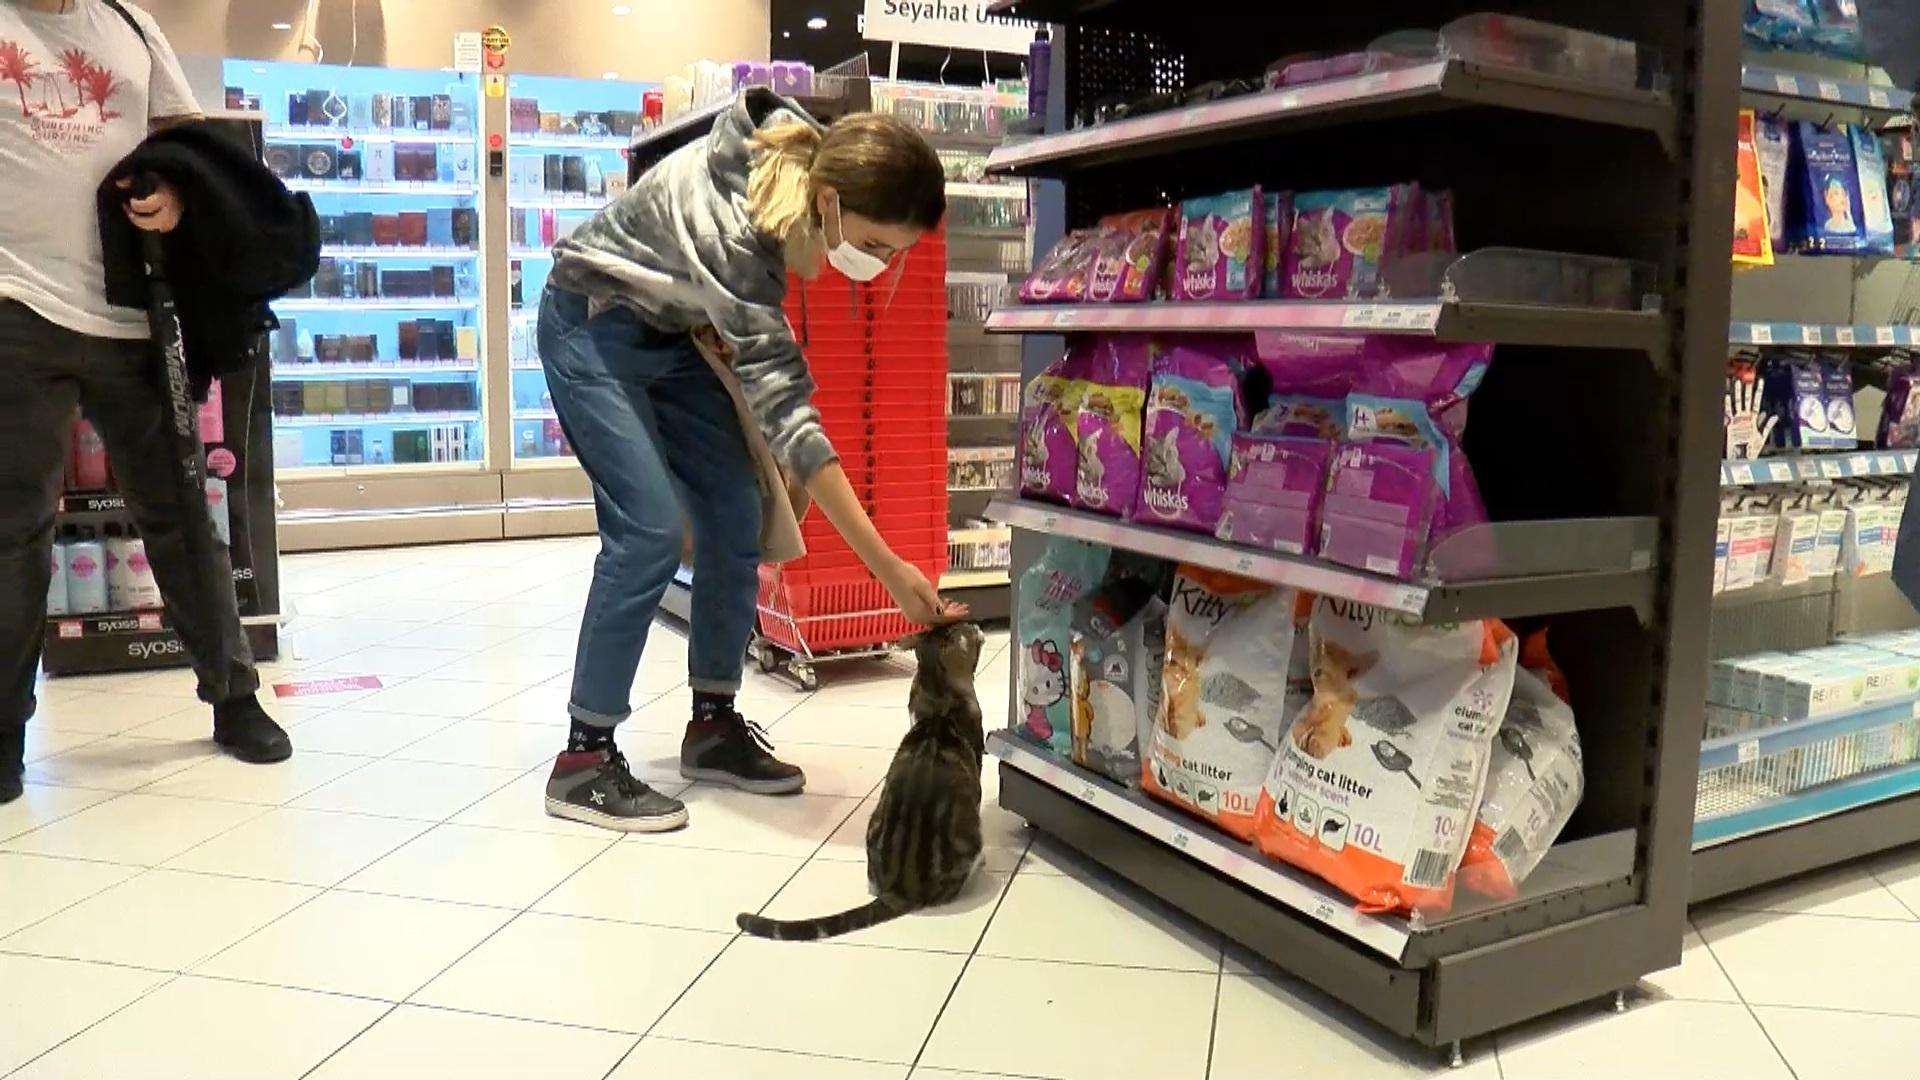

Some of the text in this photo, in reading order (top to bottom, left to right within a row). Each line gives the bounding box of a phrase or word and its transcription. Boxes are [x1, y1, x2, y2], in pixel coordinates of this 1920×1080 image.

[884, 0, 969, 23] Seyahat
[1183, 273, 1217, 292] whiska
[1291, 270, 1338, 289] whiskas
[1144, 487, 1189, 511] whiskas
[1173, 577, 1230, 626] Kitty
[1182, 758, 1233, 782] cat litter
[1317, 768, 1336, 785] cat
[1338, 774, 1373, 798] litter
[1354, 823, 1384, 851] 10L
